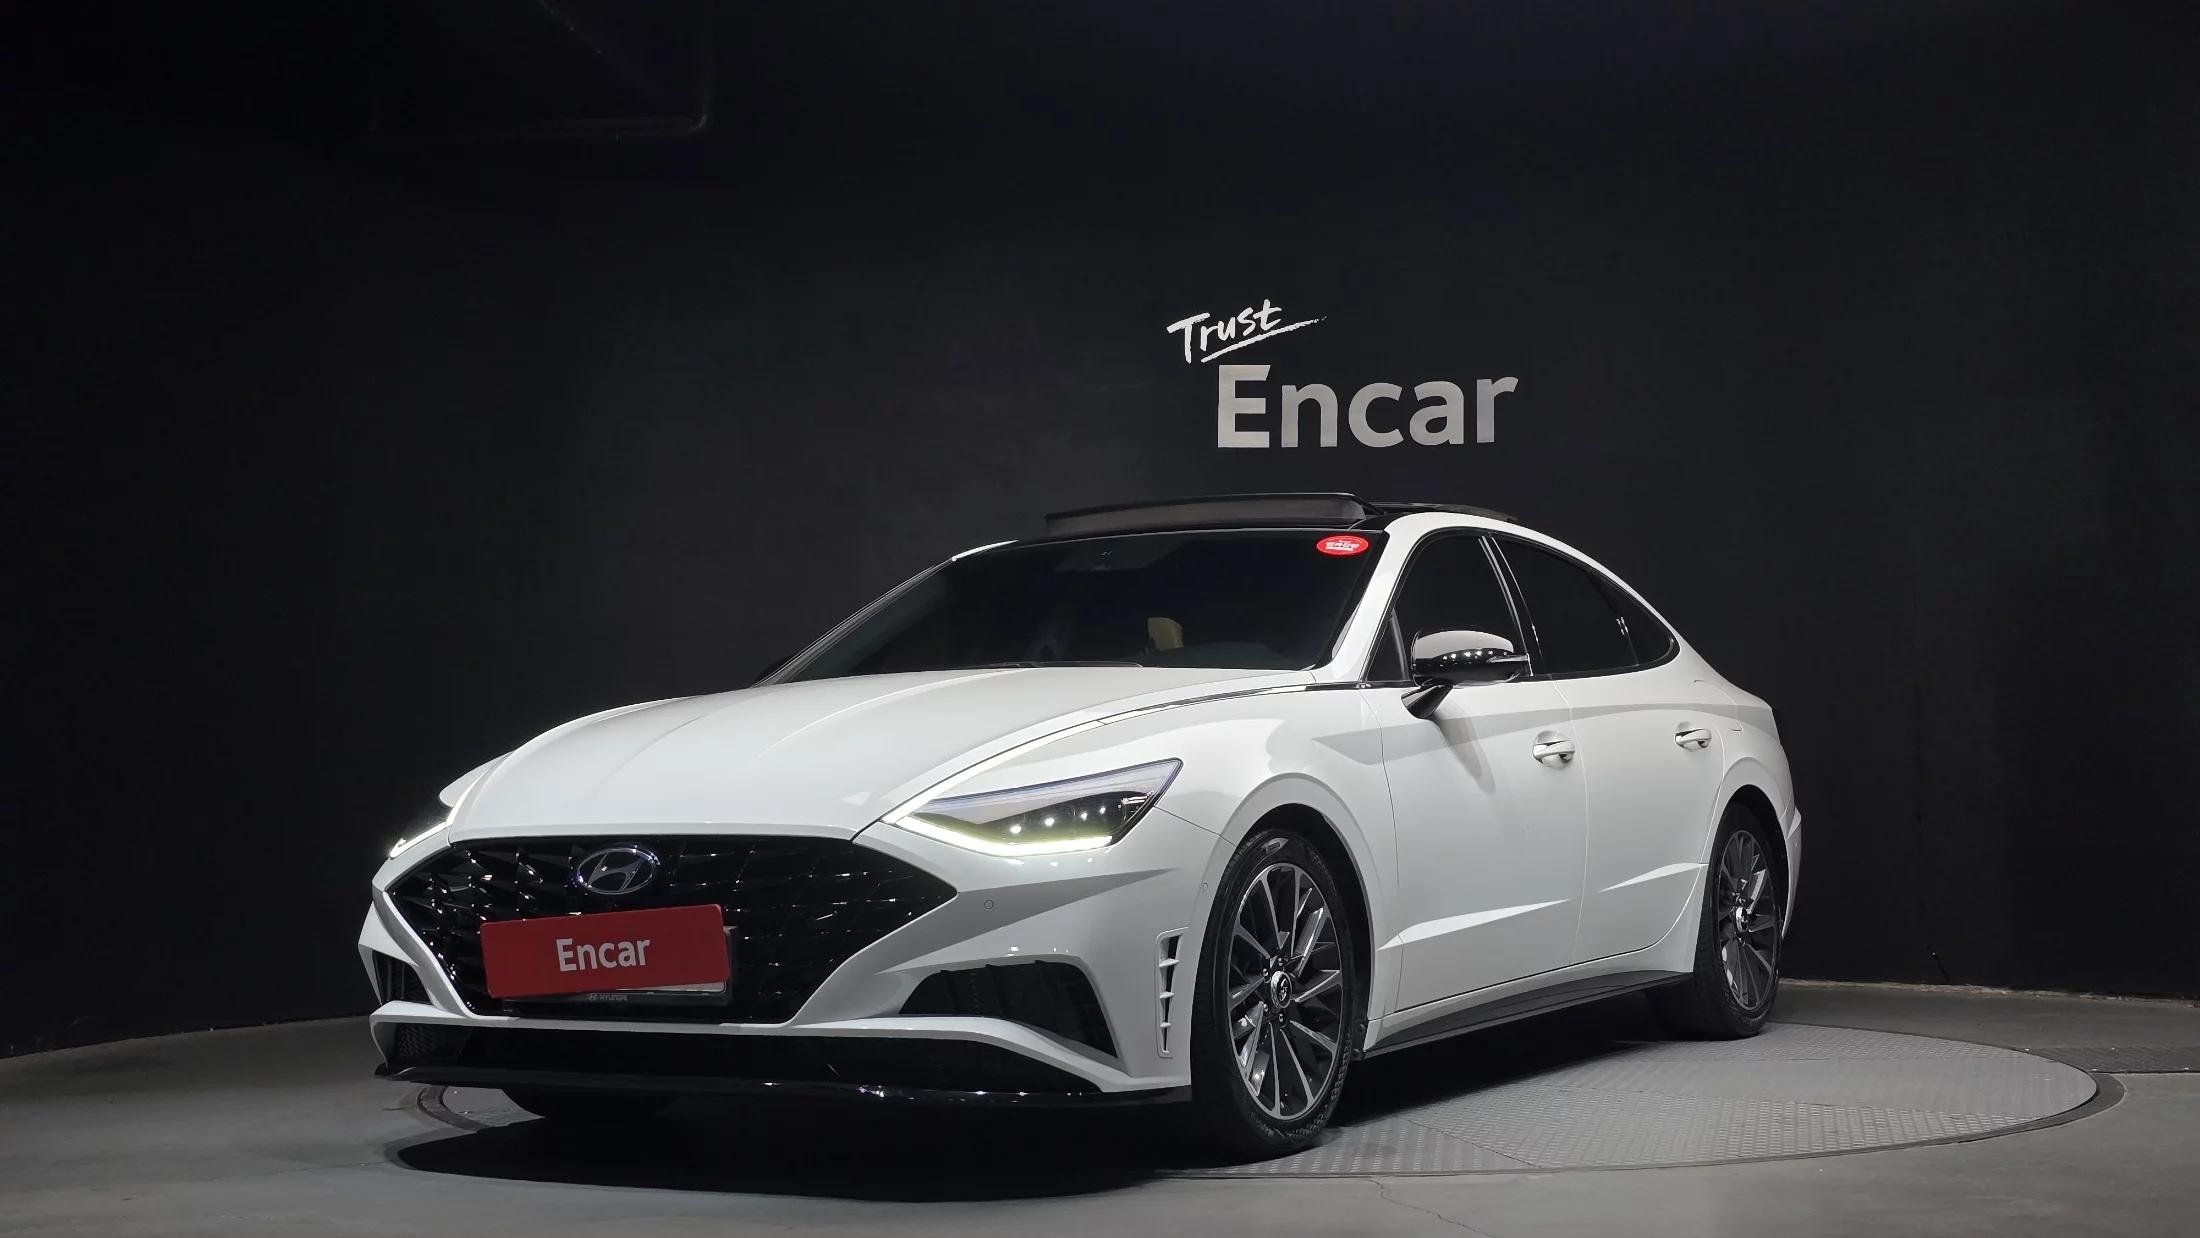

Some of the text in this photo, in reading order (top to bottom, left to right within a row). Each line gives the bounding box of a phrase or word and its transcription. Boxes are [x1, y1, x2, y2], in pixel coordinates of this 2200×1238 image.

[1166, 299, 1282, 364] Trust
[1217, 364, 1519, 448] Encar
[556, 937, 650, 972] Encar
